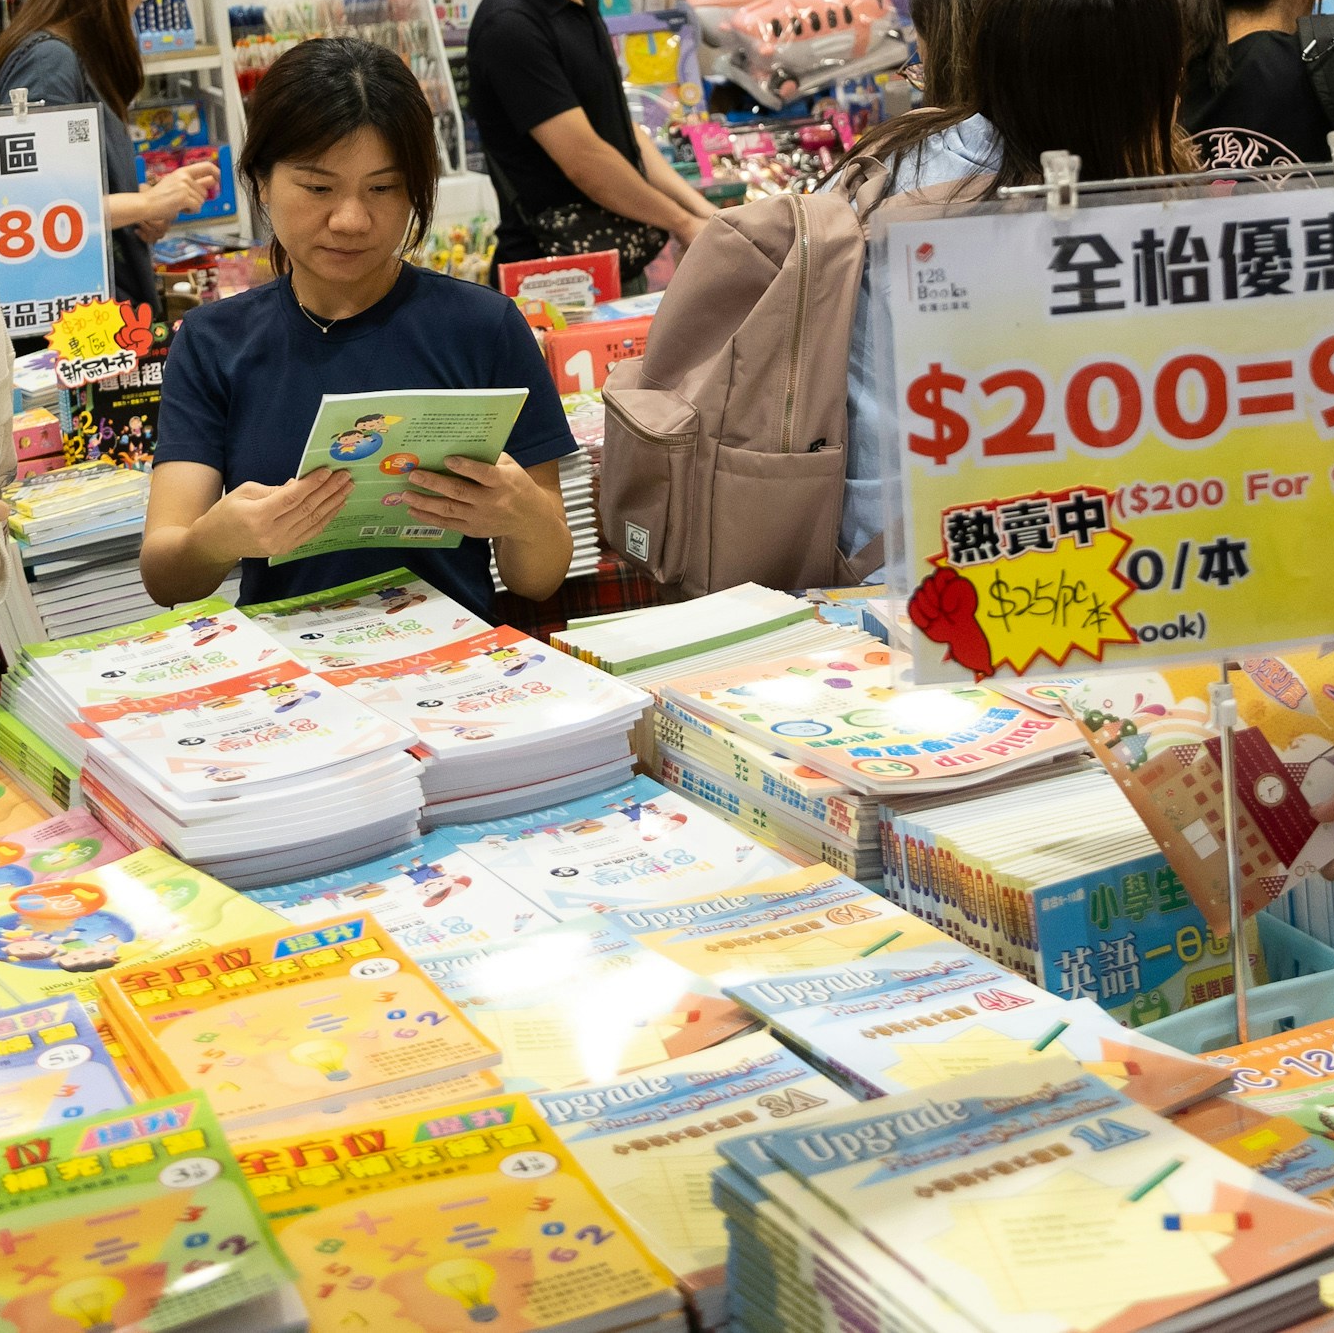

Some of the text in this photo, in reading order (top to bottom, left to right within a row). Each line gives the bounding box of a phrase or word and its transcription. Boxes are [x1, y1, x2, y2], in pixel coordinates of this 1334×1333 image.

[917, 268, 946, 283] 128
[918, 282, 967, 300] Books
[60, 353, 136, 386] 新品上市
[99, 363, 165, 392] 邏輯超
[1115, 480, 1224, 519] ($200
[1247, 472, 1309, 501] For
[948, 494, 1108, 563] 熱賣中
[325, 650, 435, 683] MATHS
[95, 685, 213, 718] MATHS
[978, 713, 1060, 759] Build
[620, 892, 752, 934] Upgrade
[824, 904, 881, 926] 6A
[1089, 864, 1195, 932] 小學生
[119, 946, 261, 994] 全方位
[748, 967, 885, 1010] Upgrade
[1057, 931, 1144, 1008] 英語
[975, 988, 1035, 1013] 4A
[755, 1085, 827, 1118] 3A
[797, 1099, 972, 1166] Upgrade
[1071, 1115, 1150, 1154] 1A
